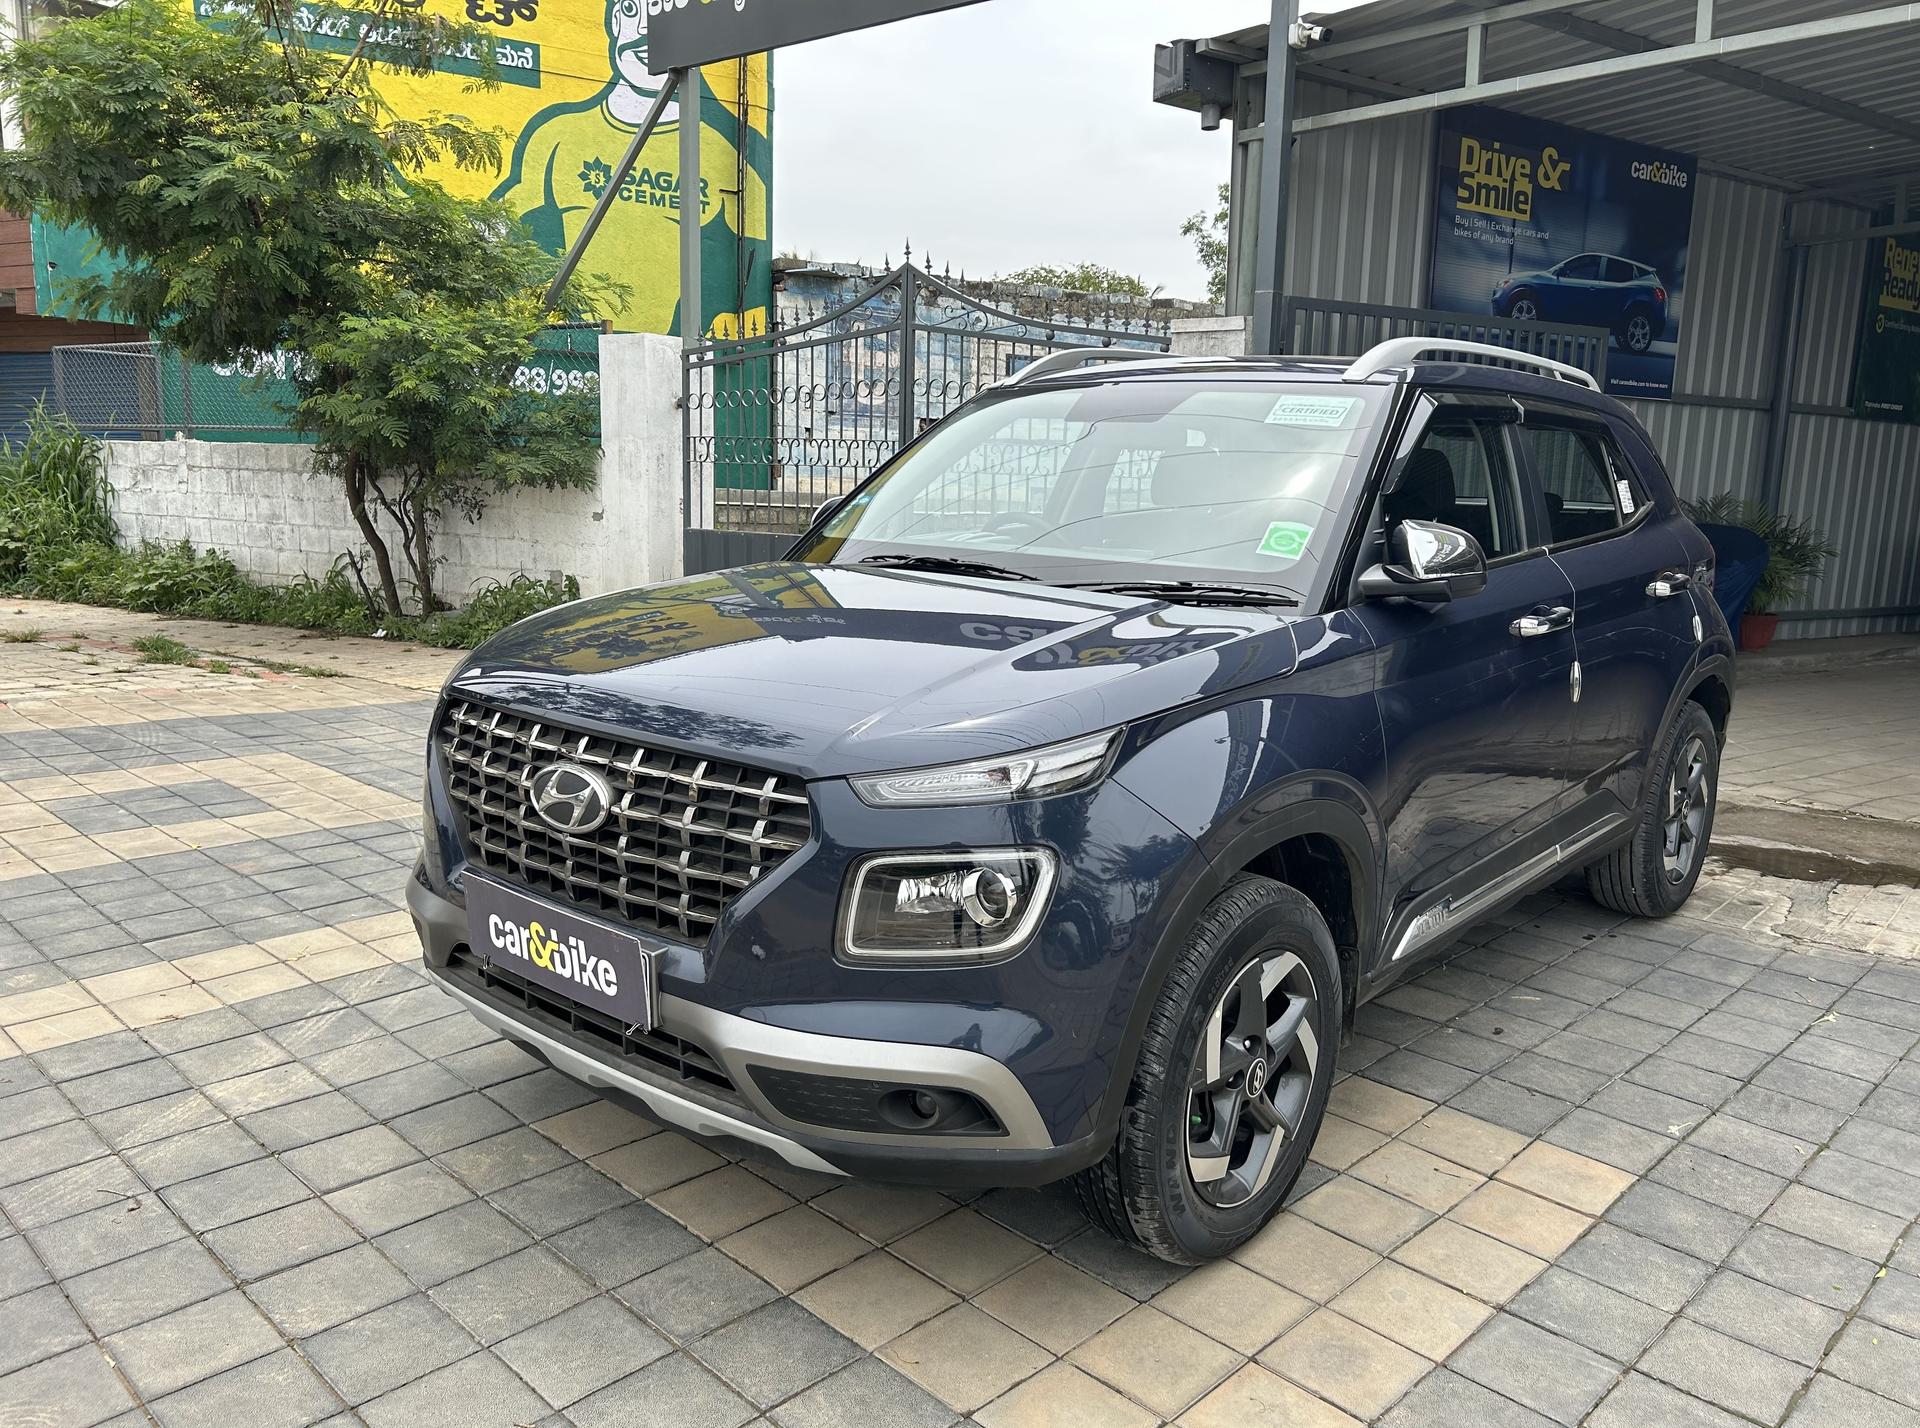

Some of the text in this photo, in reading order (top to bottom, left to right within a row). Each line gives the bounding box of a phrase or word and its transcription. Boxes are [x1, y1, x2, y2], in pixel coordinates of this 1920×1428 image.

[1459, 137, 1571, 191] Drive &
[1630, 161, 1688, 188] car&bike
[619, 187, 711, 214] CEMET
[1457, 171, 1529, 215] Smile
[1454, 228, 1514, 245] bikes of any brand
[1455, 215, 1469, 228] Buy
[1473, 217, 1487, 229] Sell
[1491, 221, 1522, 236] Exchange
[1523, 227, 1536, 237] cars
[1537, 229, 1549, 239] and
[1281, 407, 1340, 416] CERTIFIED
[488, 913, 619, 997] car&bike
